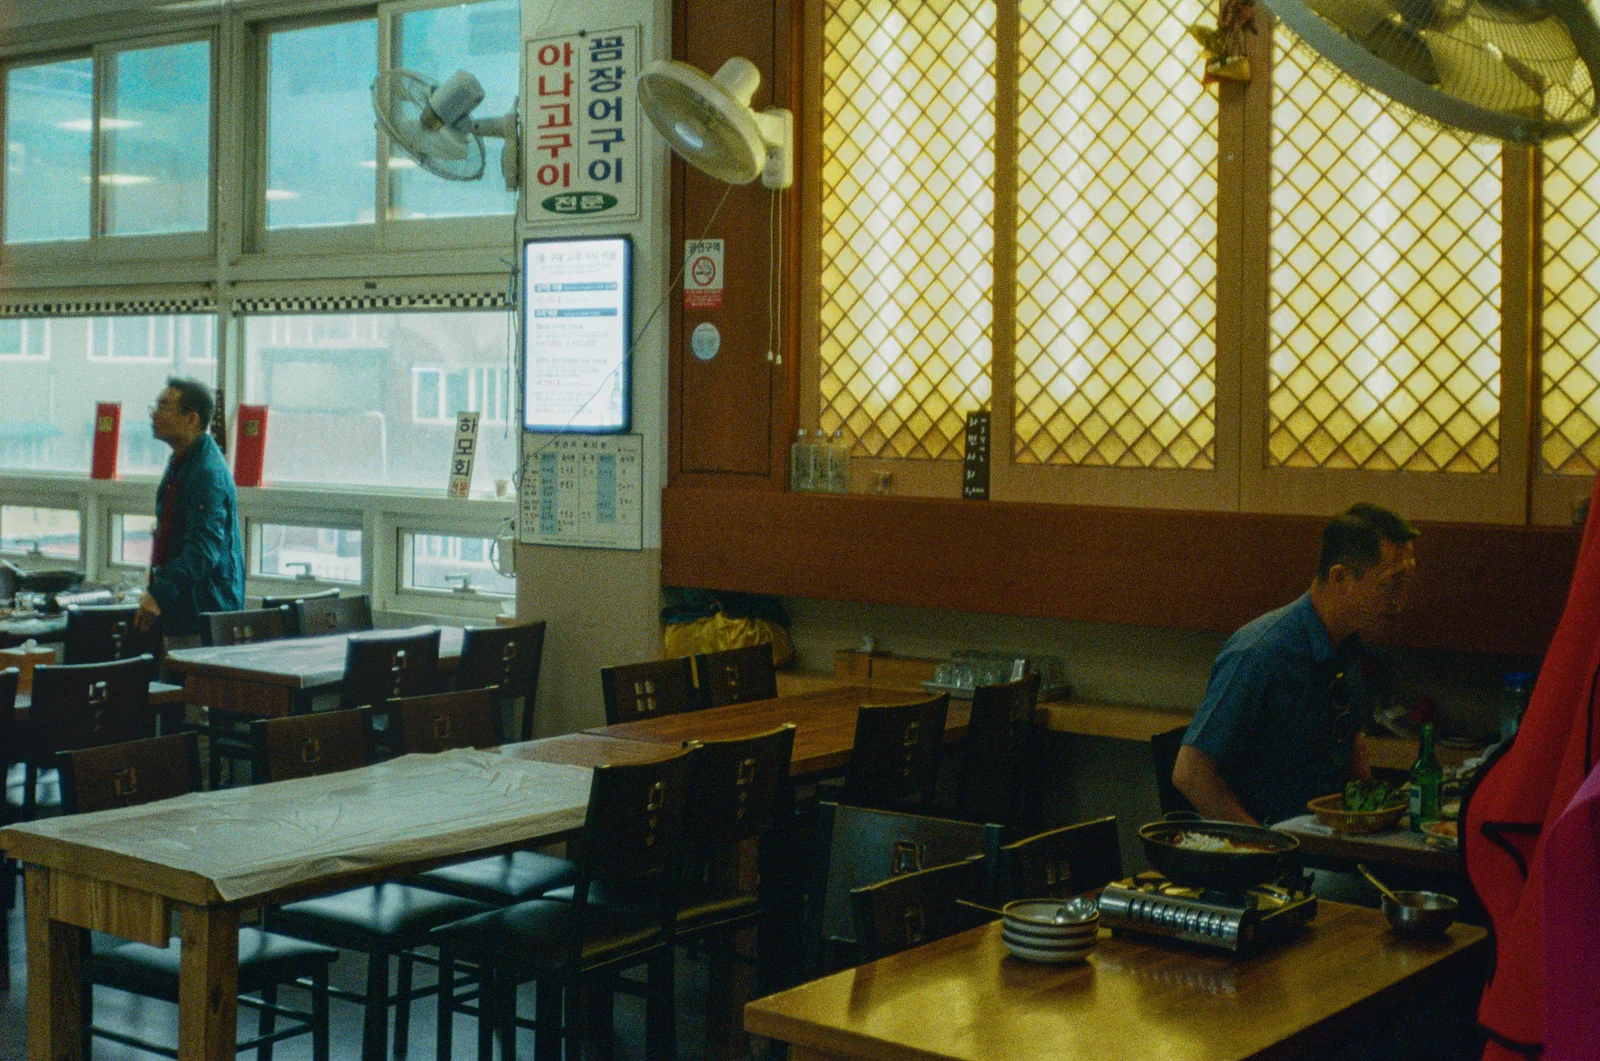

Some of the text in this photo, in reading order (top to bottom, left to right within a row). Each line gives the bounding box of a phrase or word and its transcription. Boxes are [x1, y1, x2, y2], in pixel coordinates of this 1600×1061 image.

[537, 42, 574, 187] 아나고구이
[588, 36, 626, 183] 꼼장어구이
[453, 417, 478, 476] 하모회
